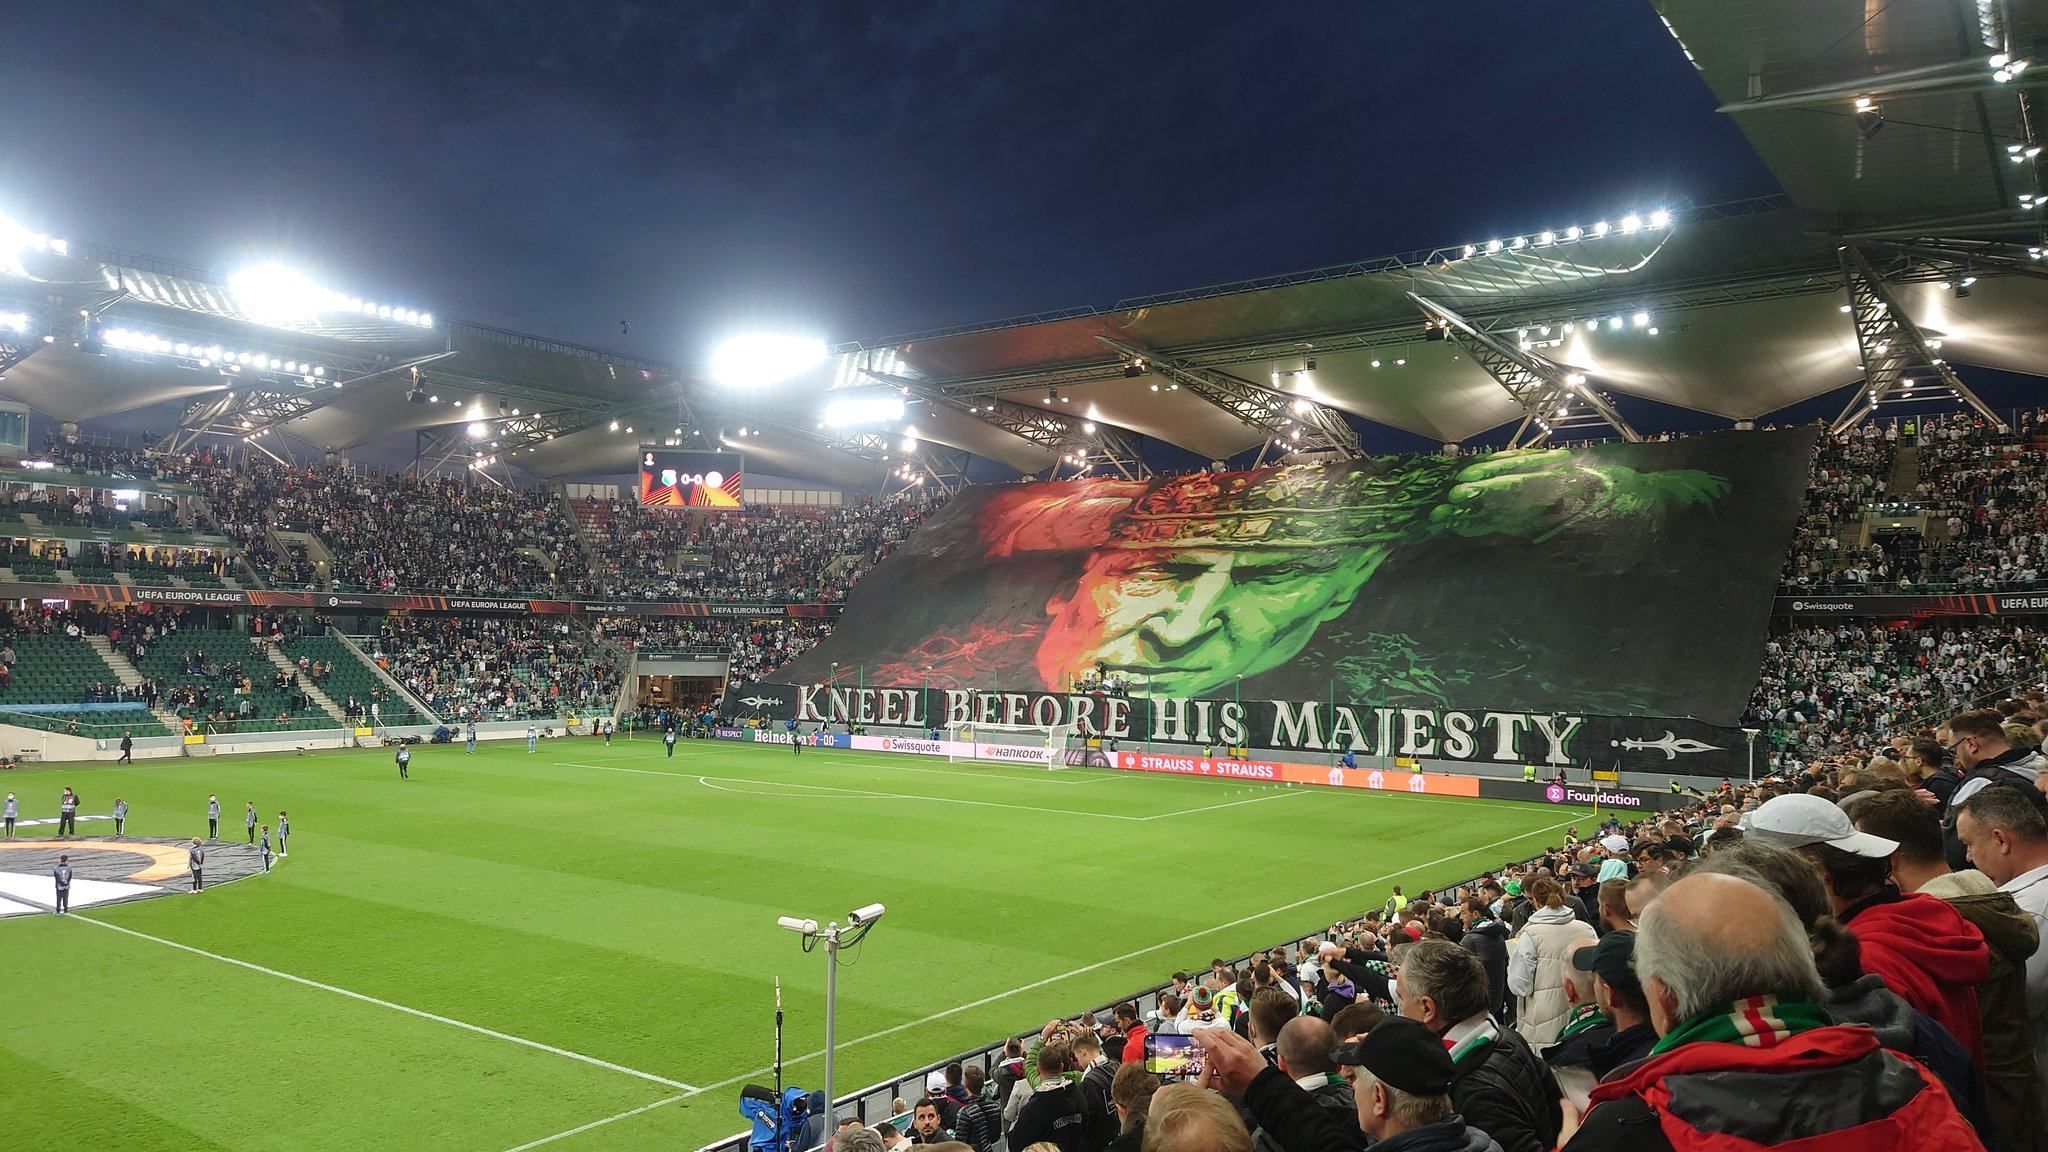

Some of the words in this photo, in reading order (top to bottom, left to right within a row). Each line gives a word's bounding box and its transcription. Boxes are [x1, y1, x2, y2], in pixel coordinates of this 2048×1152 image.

[137, 591, 163, 599] UEFA
[165, 591, 203, 600] EUROPA
[205, 593, 243, 601] LEAGUE
[451, 600, 471, 608] UEFA
[471, 601, 499, 609] EUROPA
[499, 602, 526, 610] LEAGUE
[1803, 602, 1854, 612] Swissquote
[2001, 598, 2029, 609] UEFA
[797, 683, 925, 726] KNEEL
[944, 689, 1132, 738] BEFORE
[1150, 698, 1247, 745] HIS
[1270, 699, 1582, 764] MAJESTY
[722, 730, 743, 738] RESPECT
[892, 739, 941, 753] Swissquote
[1141, 756, 1194, 772] STRAUSS
[1216, 762, 1274, 778] STRAUSS
[1567, 789, 1641, 806] Foundation
